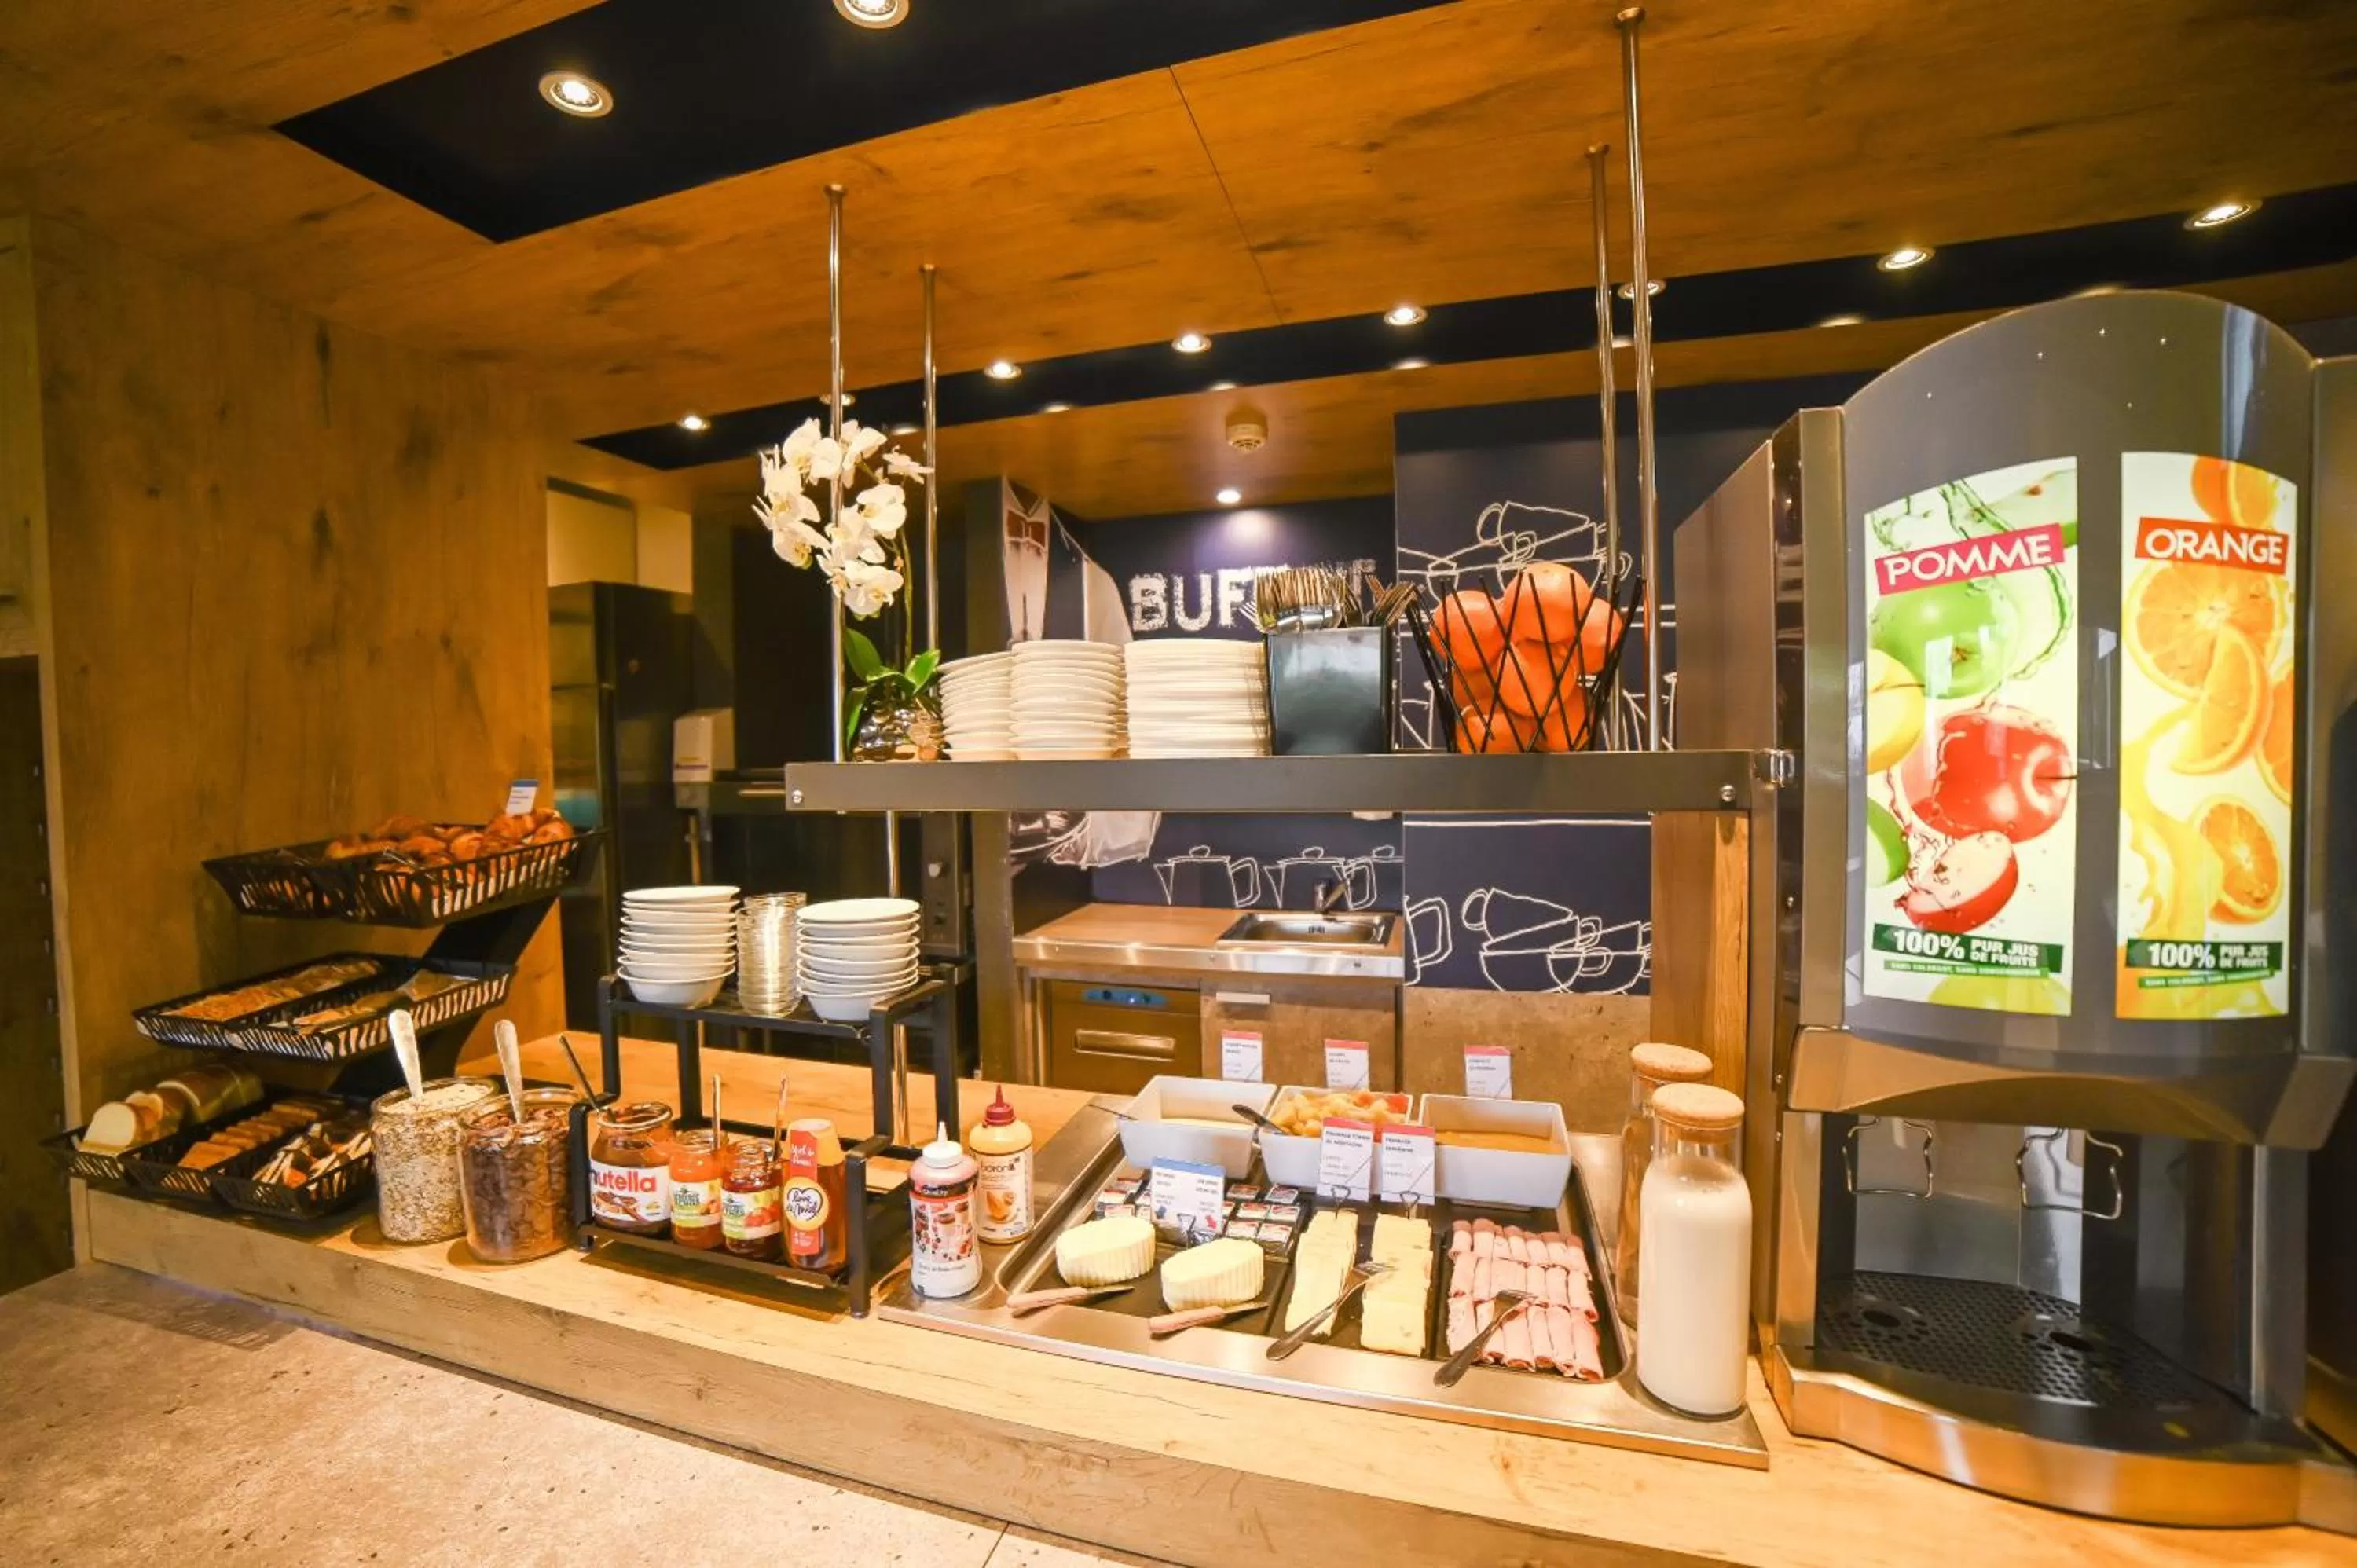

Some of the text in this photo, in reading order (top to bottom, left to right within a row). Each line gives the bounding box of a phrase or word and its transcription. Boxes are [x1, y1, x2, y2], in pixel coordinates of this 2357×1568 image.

[1884, 534, 2052, 587] POMME
[2145, 529, 2282, 566] ORANGE
[1893, 929, 2039, 960] 100% PUR JUS
[2148, 943, 2269, 969] 100% PUR JUS
[1970, 950, 2038, 968] DE FRUITS
[589, 1169, 658, 1193] nutella
